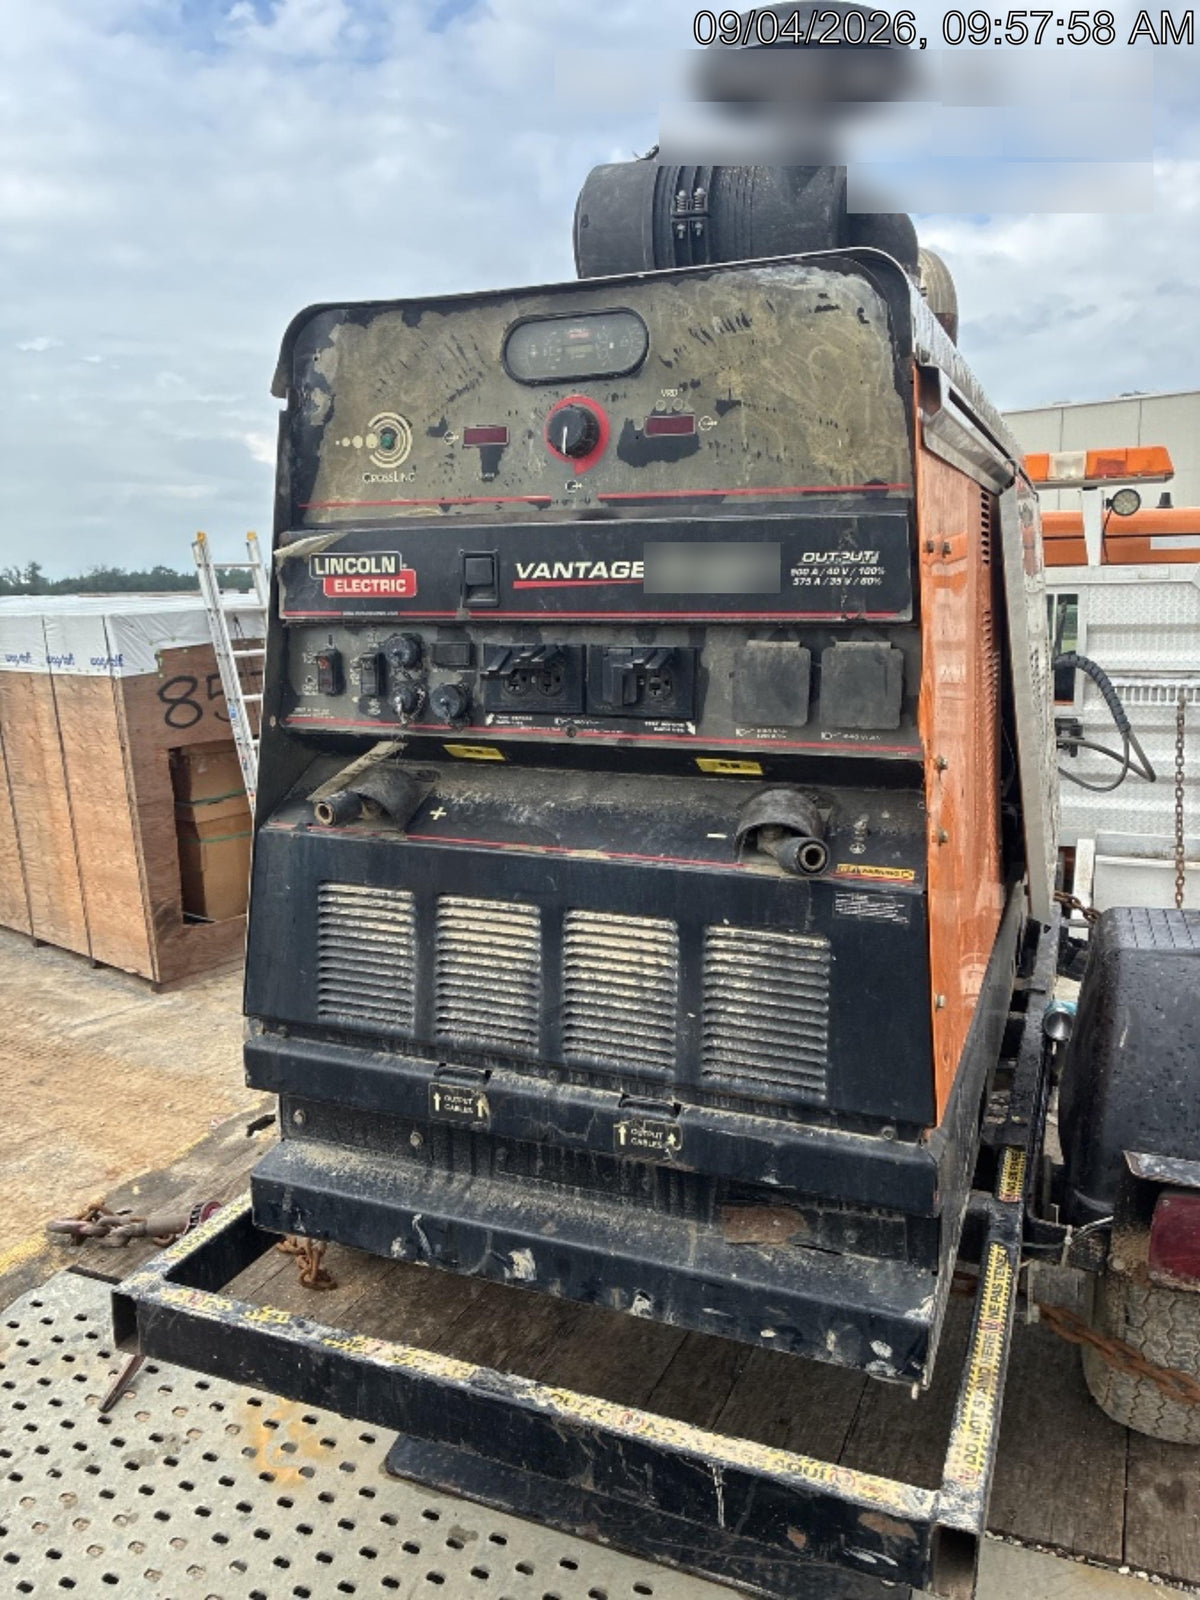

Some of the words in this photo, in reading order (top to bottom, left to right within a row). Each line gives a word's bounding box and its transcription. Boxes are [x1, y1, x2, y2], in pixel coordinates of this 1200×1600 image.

[800, 550, 880, 564] OUTPUT
[314, 556, 396, 575] LINCOLN
[514, 561, 645, 579] VANTAGE
[334, 579, 407, 593] ELECTRIC
